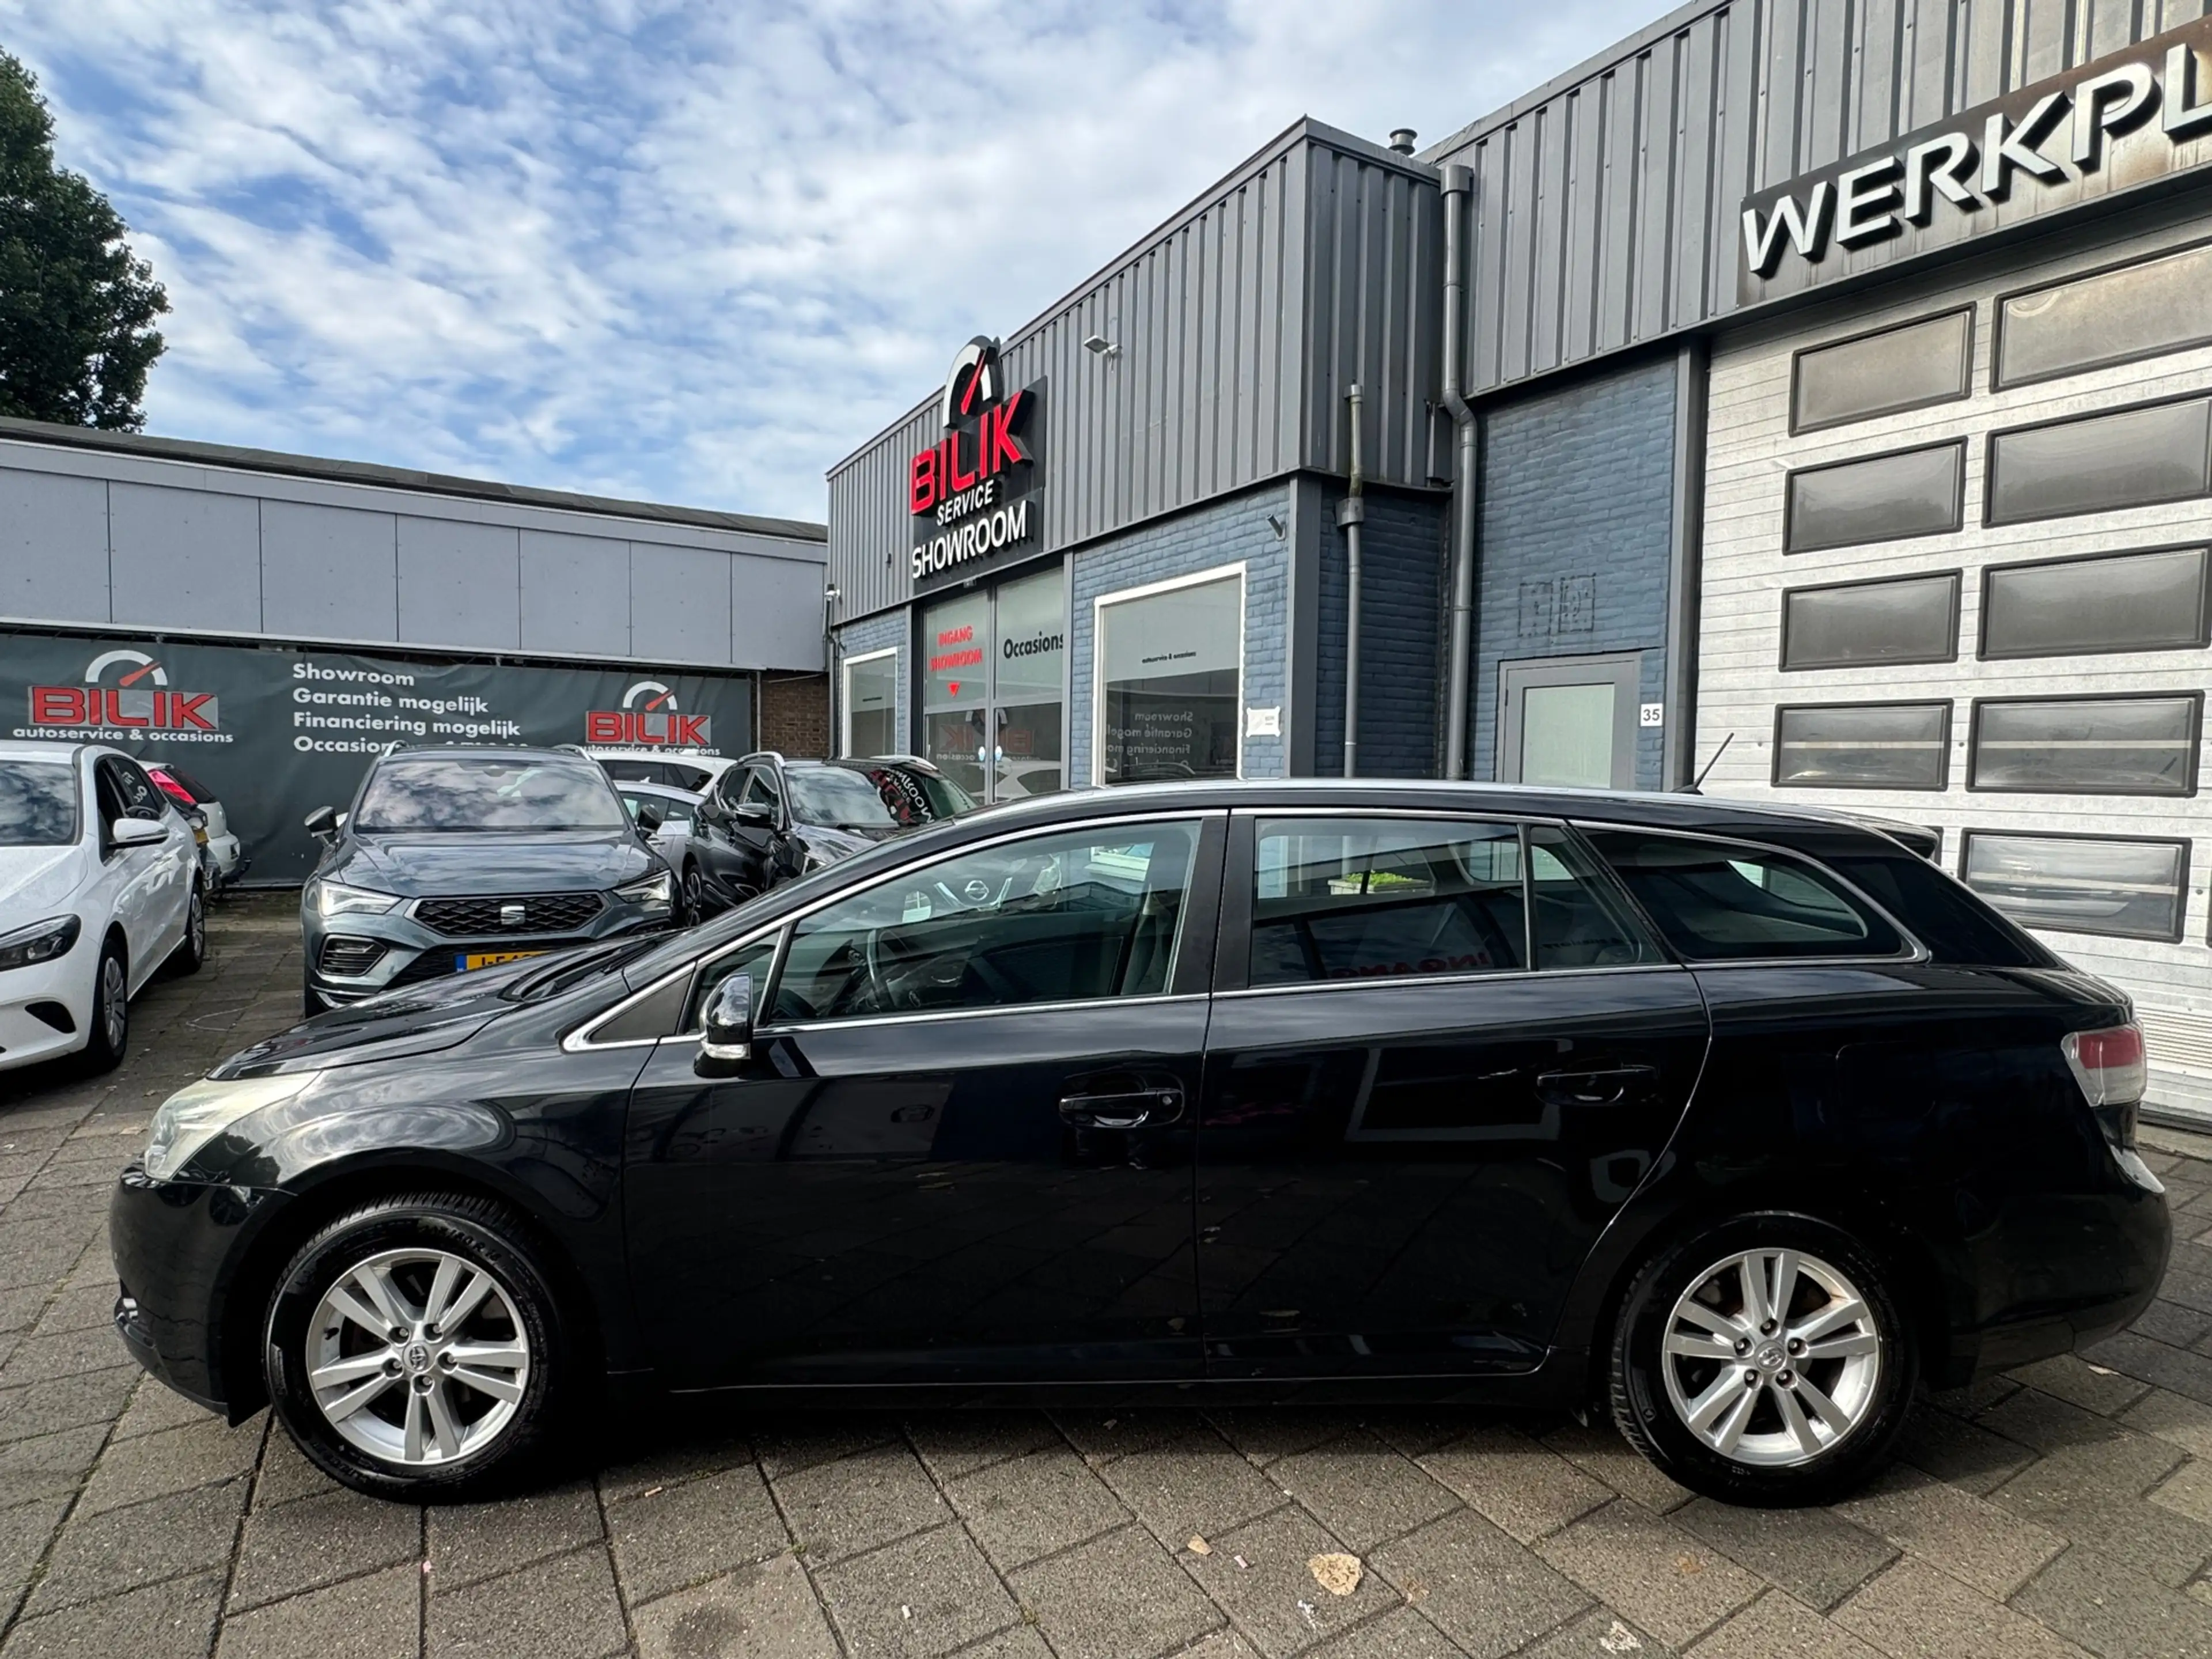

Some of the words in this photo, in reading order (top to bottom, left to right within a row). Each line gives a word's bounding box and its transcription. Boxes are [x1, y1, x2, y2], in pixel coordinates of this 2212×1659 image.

[911, 391, 1024, 516] BILIK
[937, 479, 995, 526] SERVICE
[912, 500, 1027, 579] SHOWROOM
[937, 625, 974, 647] INGANG
[1003, 630, 1063, 659] Occasions
[930, 648, 983, 672] SHOWROOM
[292, 663, 415, 686] Showroom
[32, 686, 217, 730] BILIK
[293, 687, 392, 707] Garantie
[399, 695, 488, 715] mogelijk
[1642, 708, 1661, 722] 35
[13, 726, 123, 741] autoservice
[130, 728, 143, 741] &
[149, 729, 234, 743] occasions
[293, 712, 426, 736] Financiering
[433, 719, 521, 738] mogelijk
[588, 711, 710, 746] BILIK
